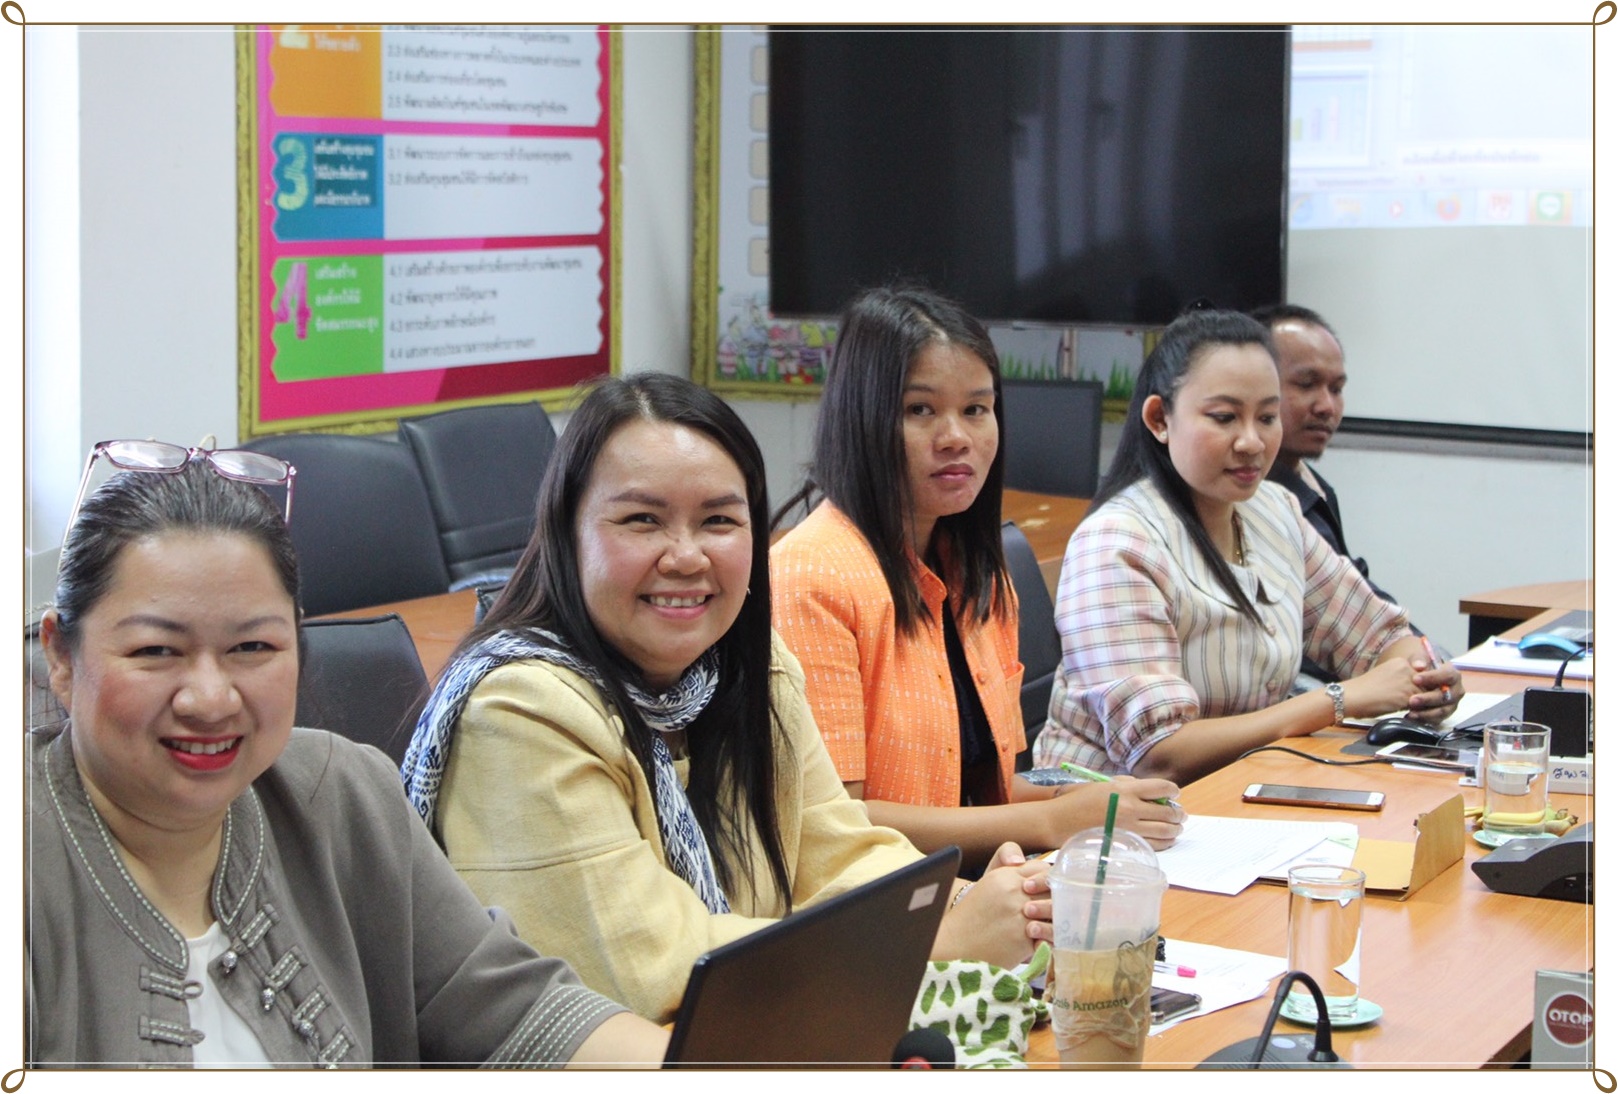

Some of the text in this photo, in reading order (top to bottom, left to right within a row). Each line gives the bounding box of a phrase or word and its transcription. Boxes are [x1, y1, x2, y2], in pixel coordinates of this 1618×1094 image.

[277, 138, 308, 210] 3
[1073, 997, 1129, 1011] Amazon
[1549, 1008, 1593, 1026] OTOP
